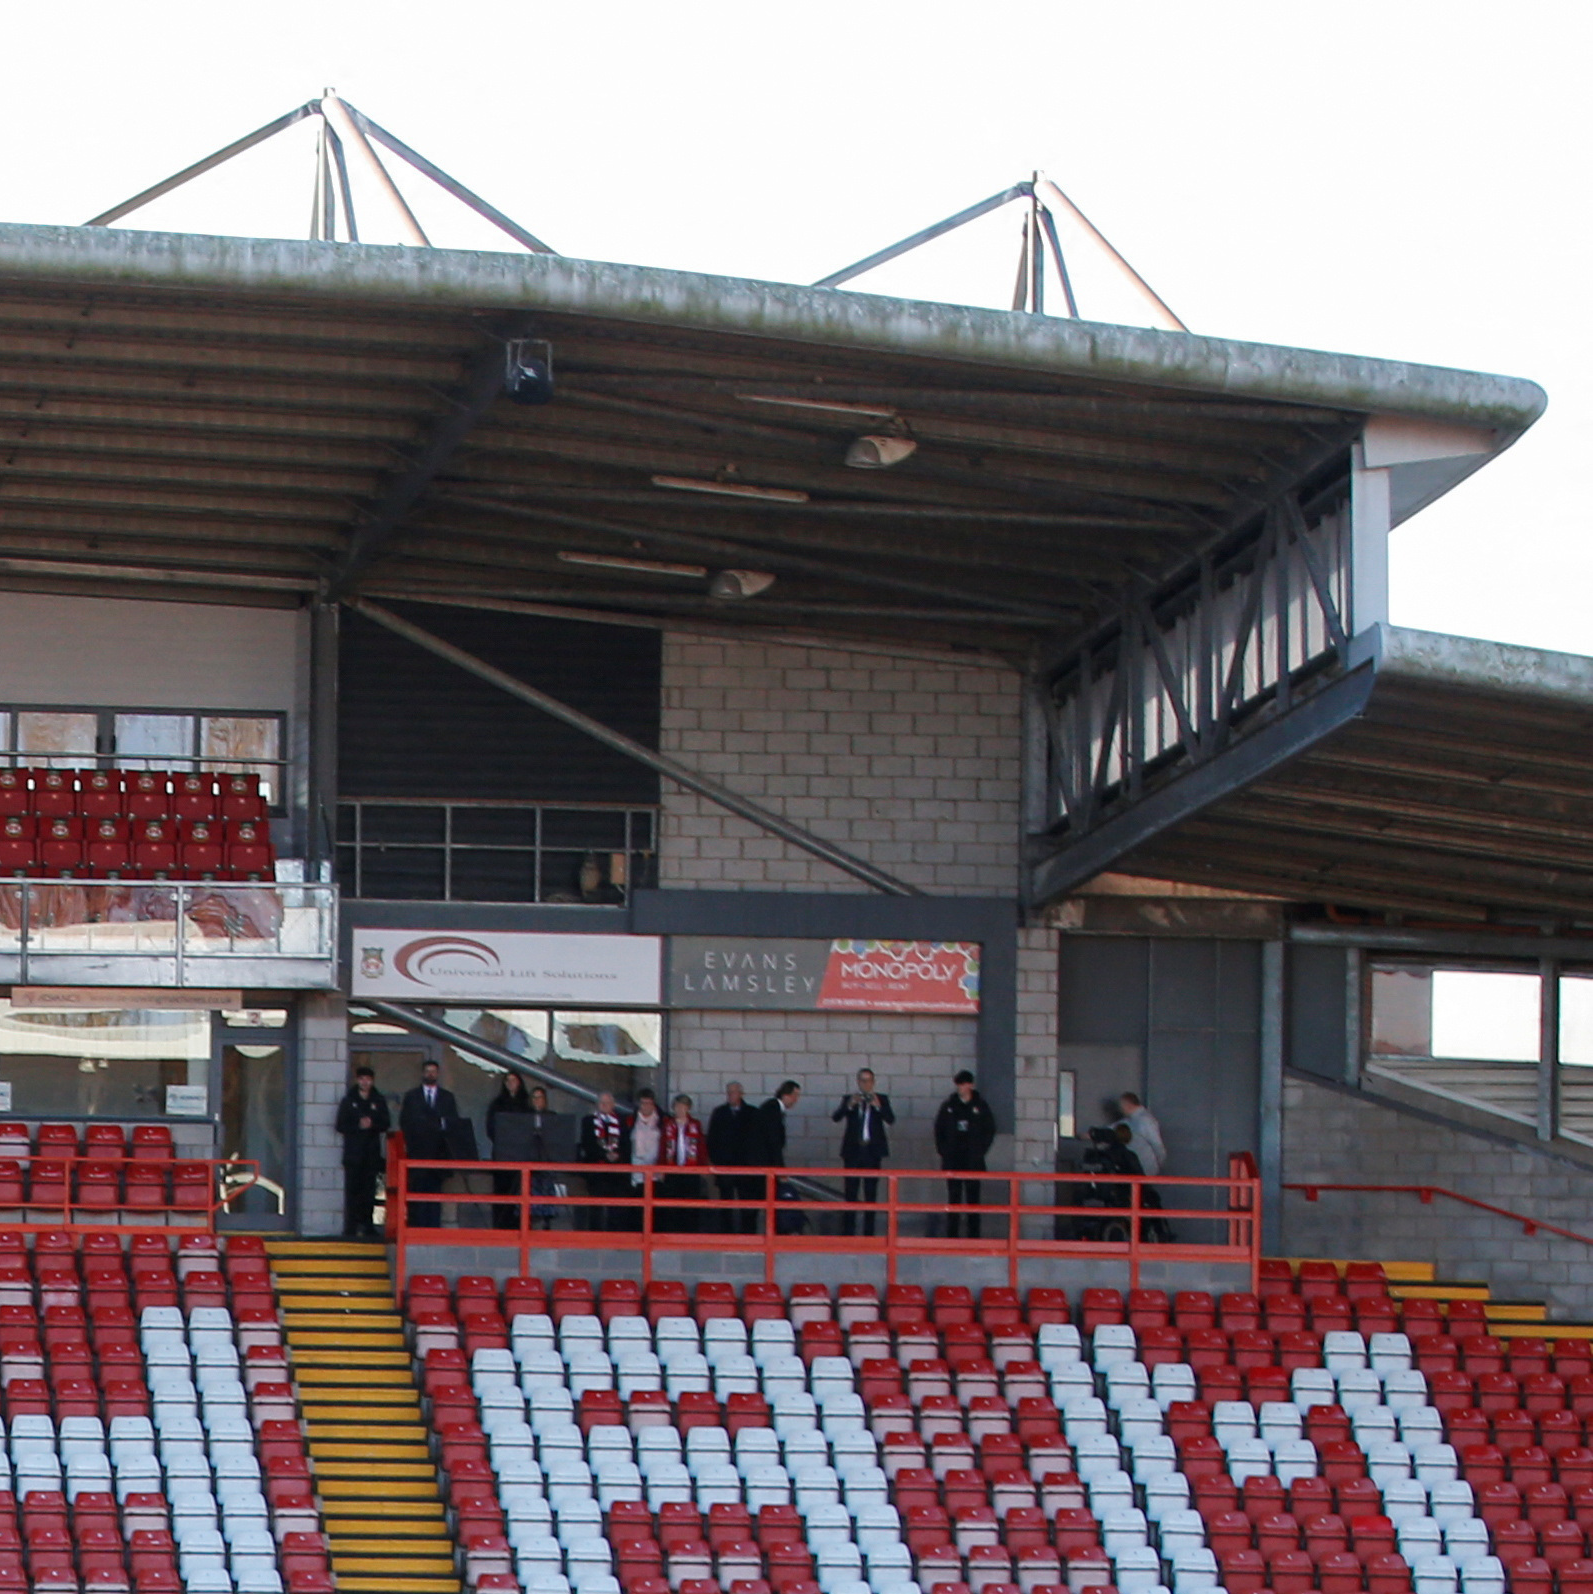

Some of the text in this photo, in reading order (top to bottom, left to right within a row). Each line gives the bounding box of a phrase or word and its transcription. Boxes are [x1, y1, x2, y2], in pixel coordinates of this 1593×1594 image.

[704, 951, 798, 972] EVANS
[429, 966, 618, 980] Universal Lift Solutions
[840, 961, 958, 982] MONOPOLY
[684, 974, 816, 993] LAMSLEY
[250, 1012, 261, 1024] 2
